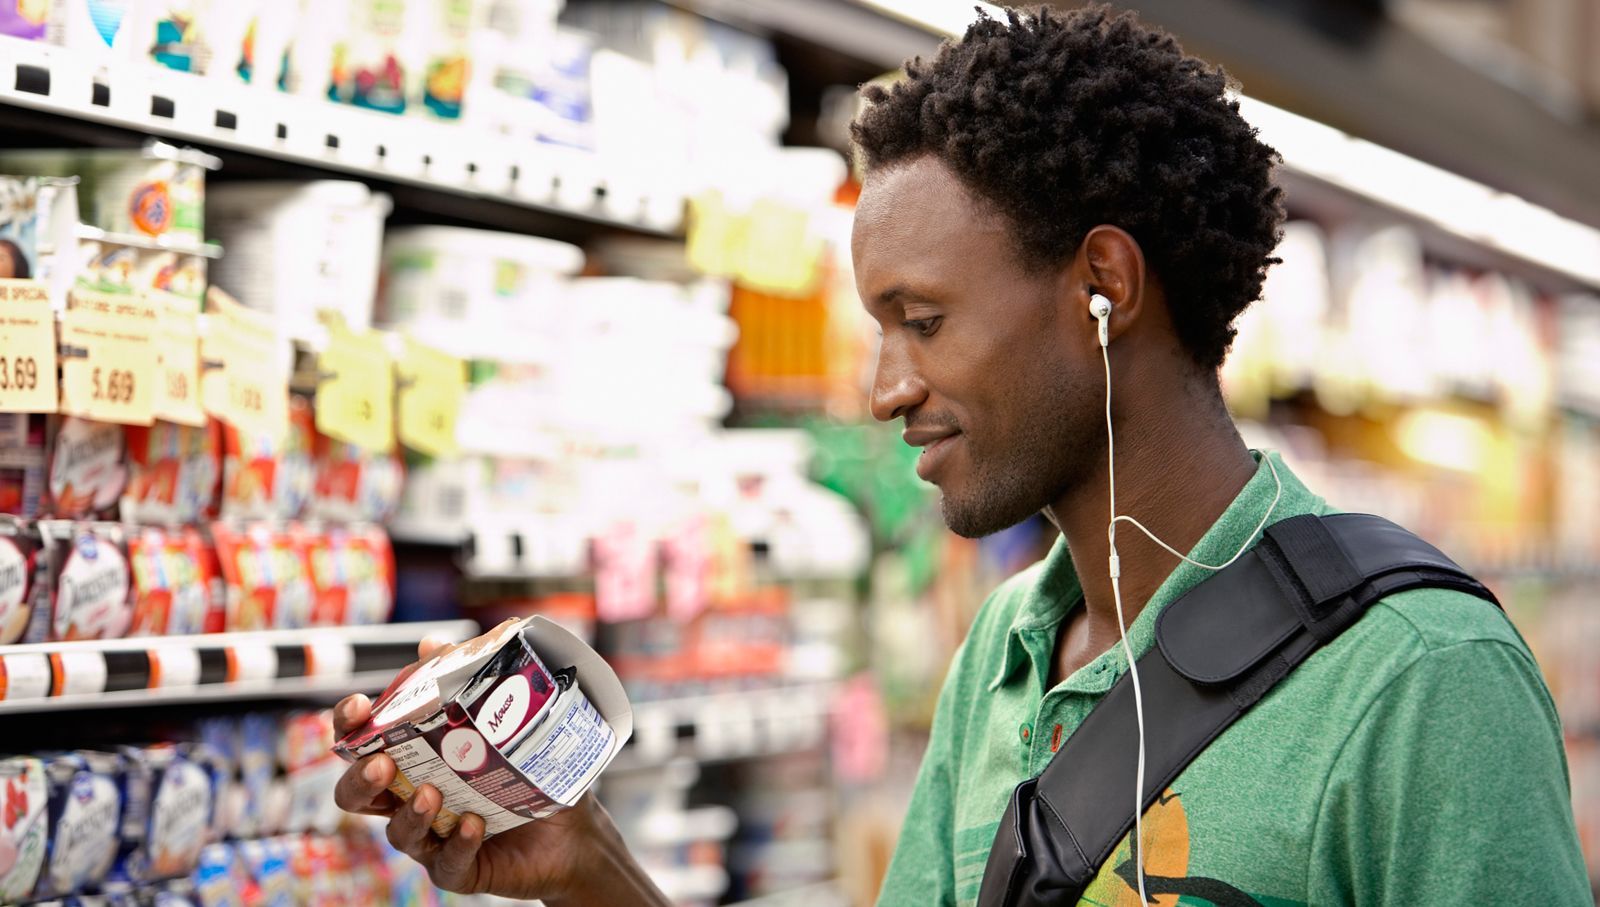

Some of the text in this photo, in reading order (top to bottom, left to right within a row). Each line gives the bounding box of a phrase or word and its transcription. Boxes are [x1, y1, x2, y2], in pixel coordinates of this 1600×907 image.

[0, 357, 38, 389] 3.69
[92, 367, 135, 404] 5.69
[488, 693, 514, 733] Mousse
